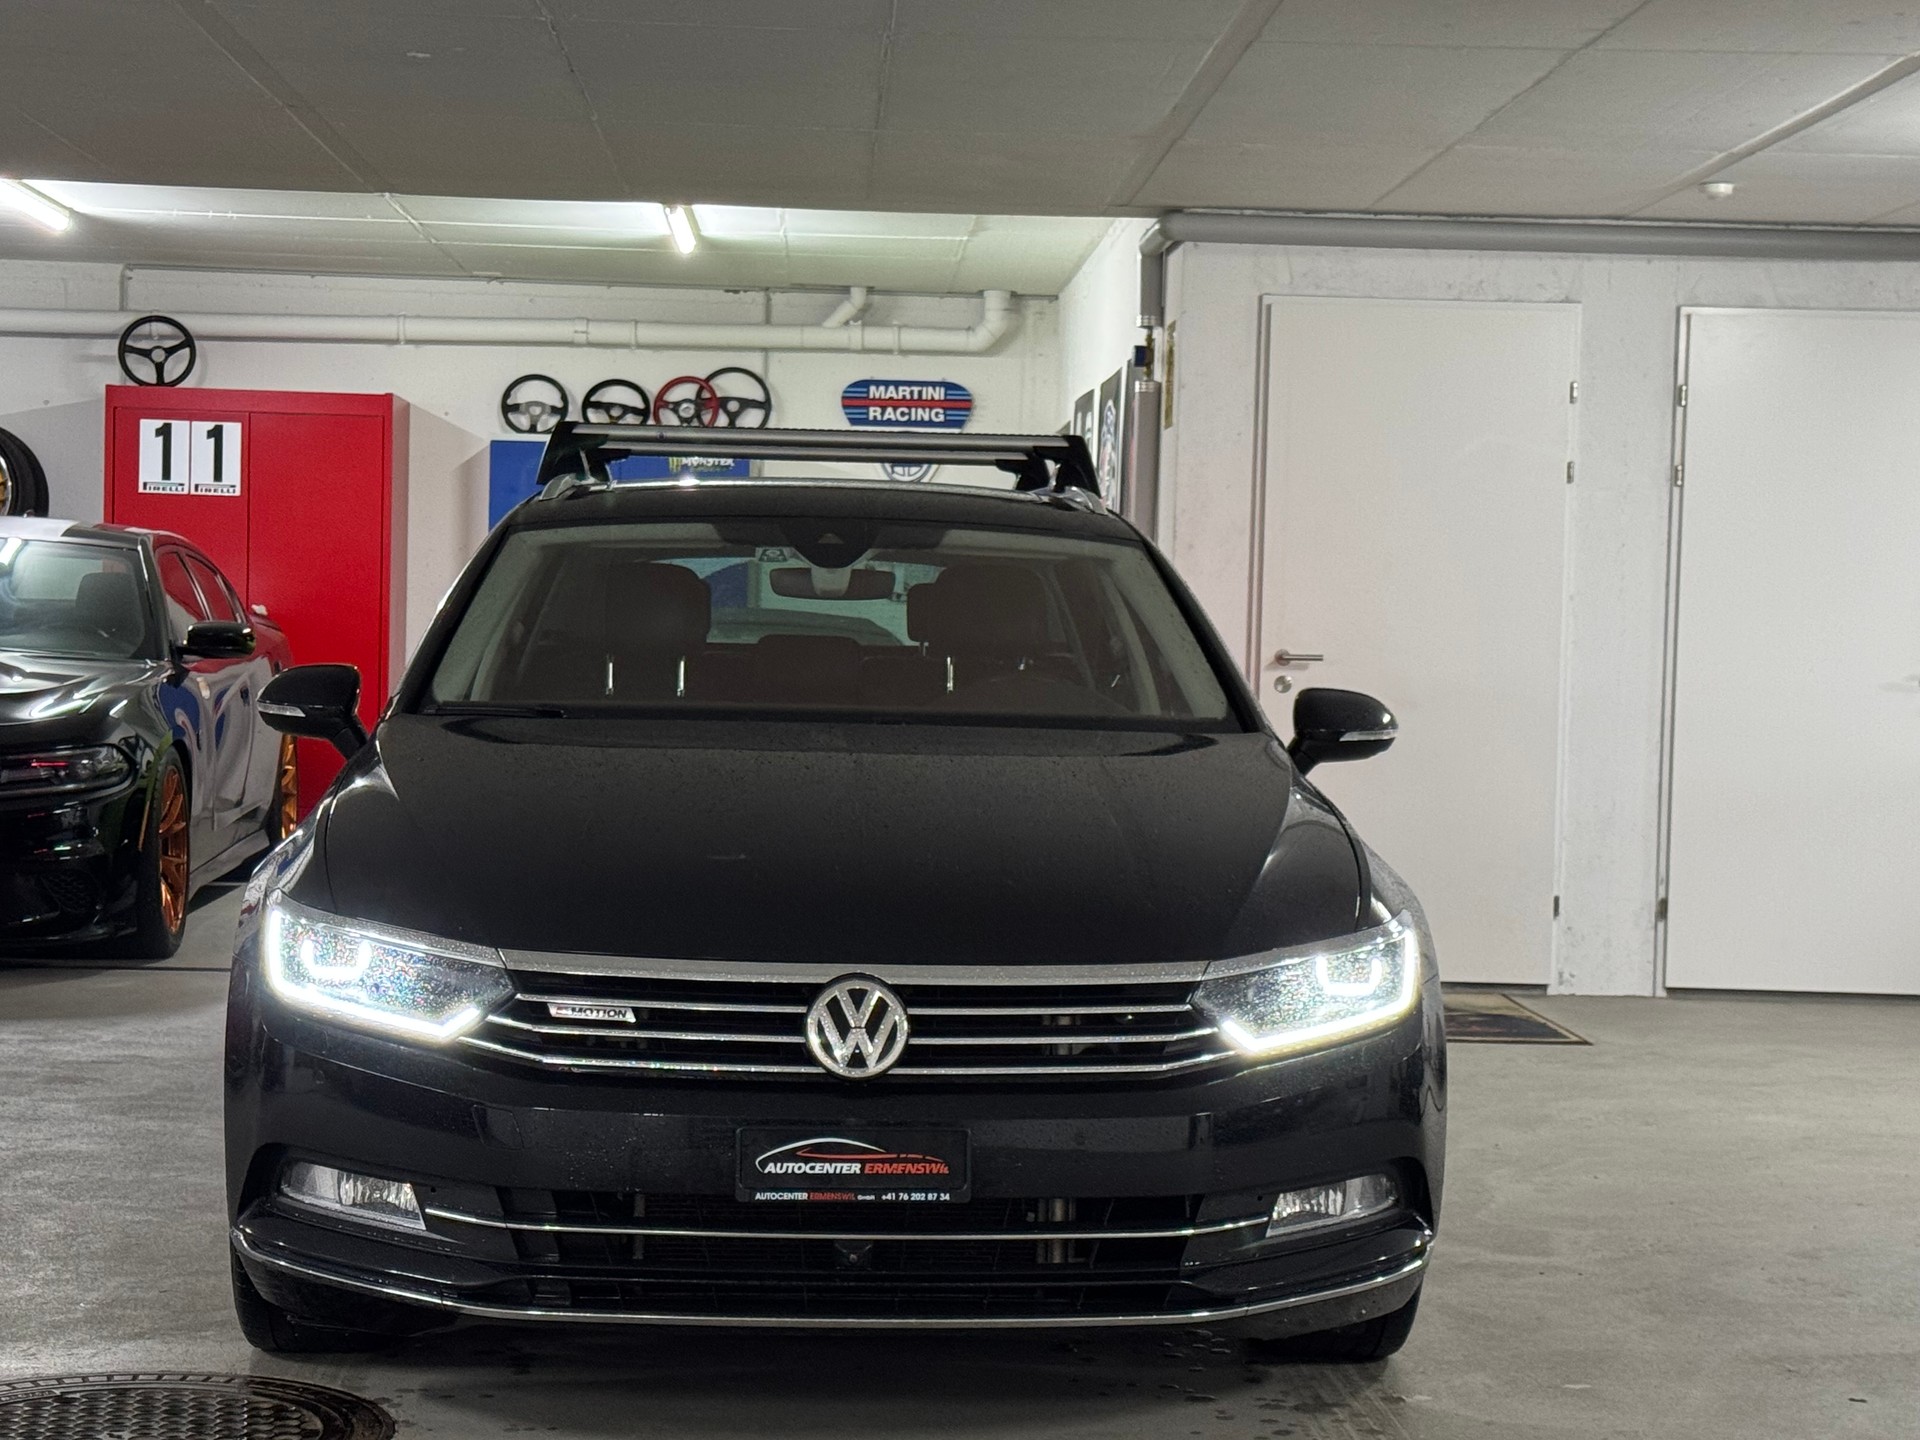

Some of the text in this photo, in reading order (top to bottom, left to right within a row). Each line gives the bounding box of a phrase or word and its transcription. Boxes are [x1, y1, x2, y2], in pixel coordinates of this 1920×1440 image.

[869, 385, 945, 400] MARTINI
[868, 406, 945, 422] RACING
[763, 1162, 862, 1174] AUTOCENTER
[755, 1192, 808, 1200] AUTOCENTER
[881, 1192, 896, 1200] +41
[898, 1192, 909, 1200] 76
[910, 1192, 926, 1200] 202
[939, 1192, 950, 1200] 34
